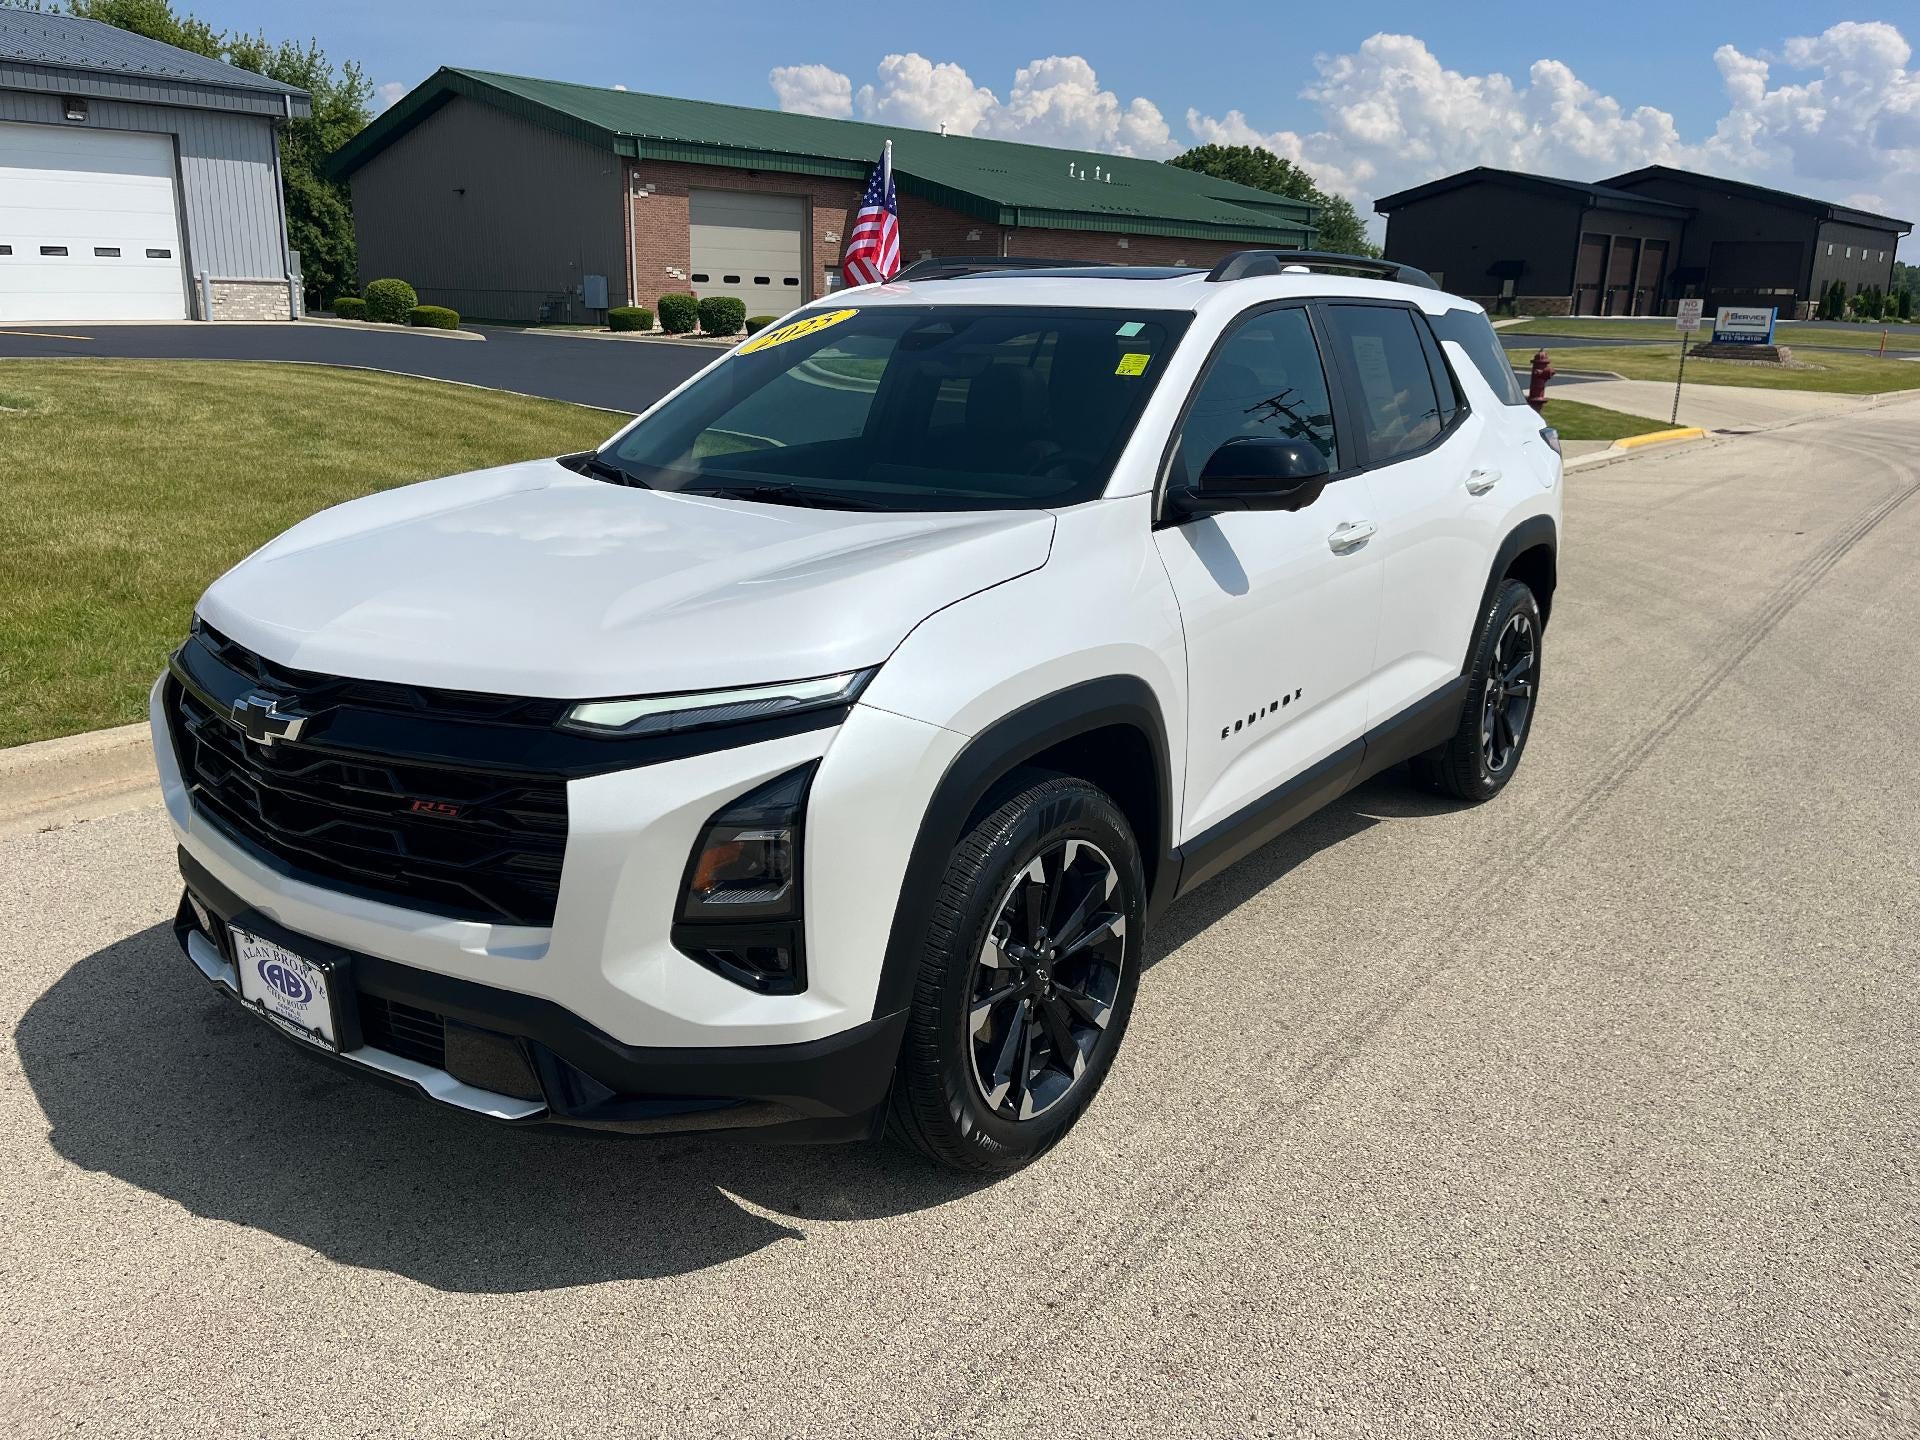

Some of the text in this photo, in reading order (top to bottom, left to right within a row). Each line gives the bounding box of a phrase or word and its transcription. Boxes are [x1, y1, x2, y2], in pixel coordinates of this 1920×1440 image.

[755, 310, 842, 351] 2025
[1221, 687, 1302, 740] EQUINOX
[412, 800, 460, 817] RS
[243, 946, 270, 960] ALAN
[273, 951, 326, 1000] BROWNE
